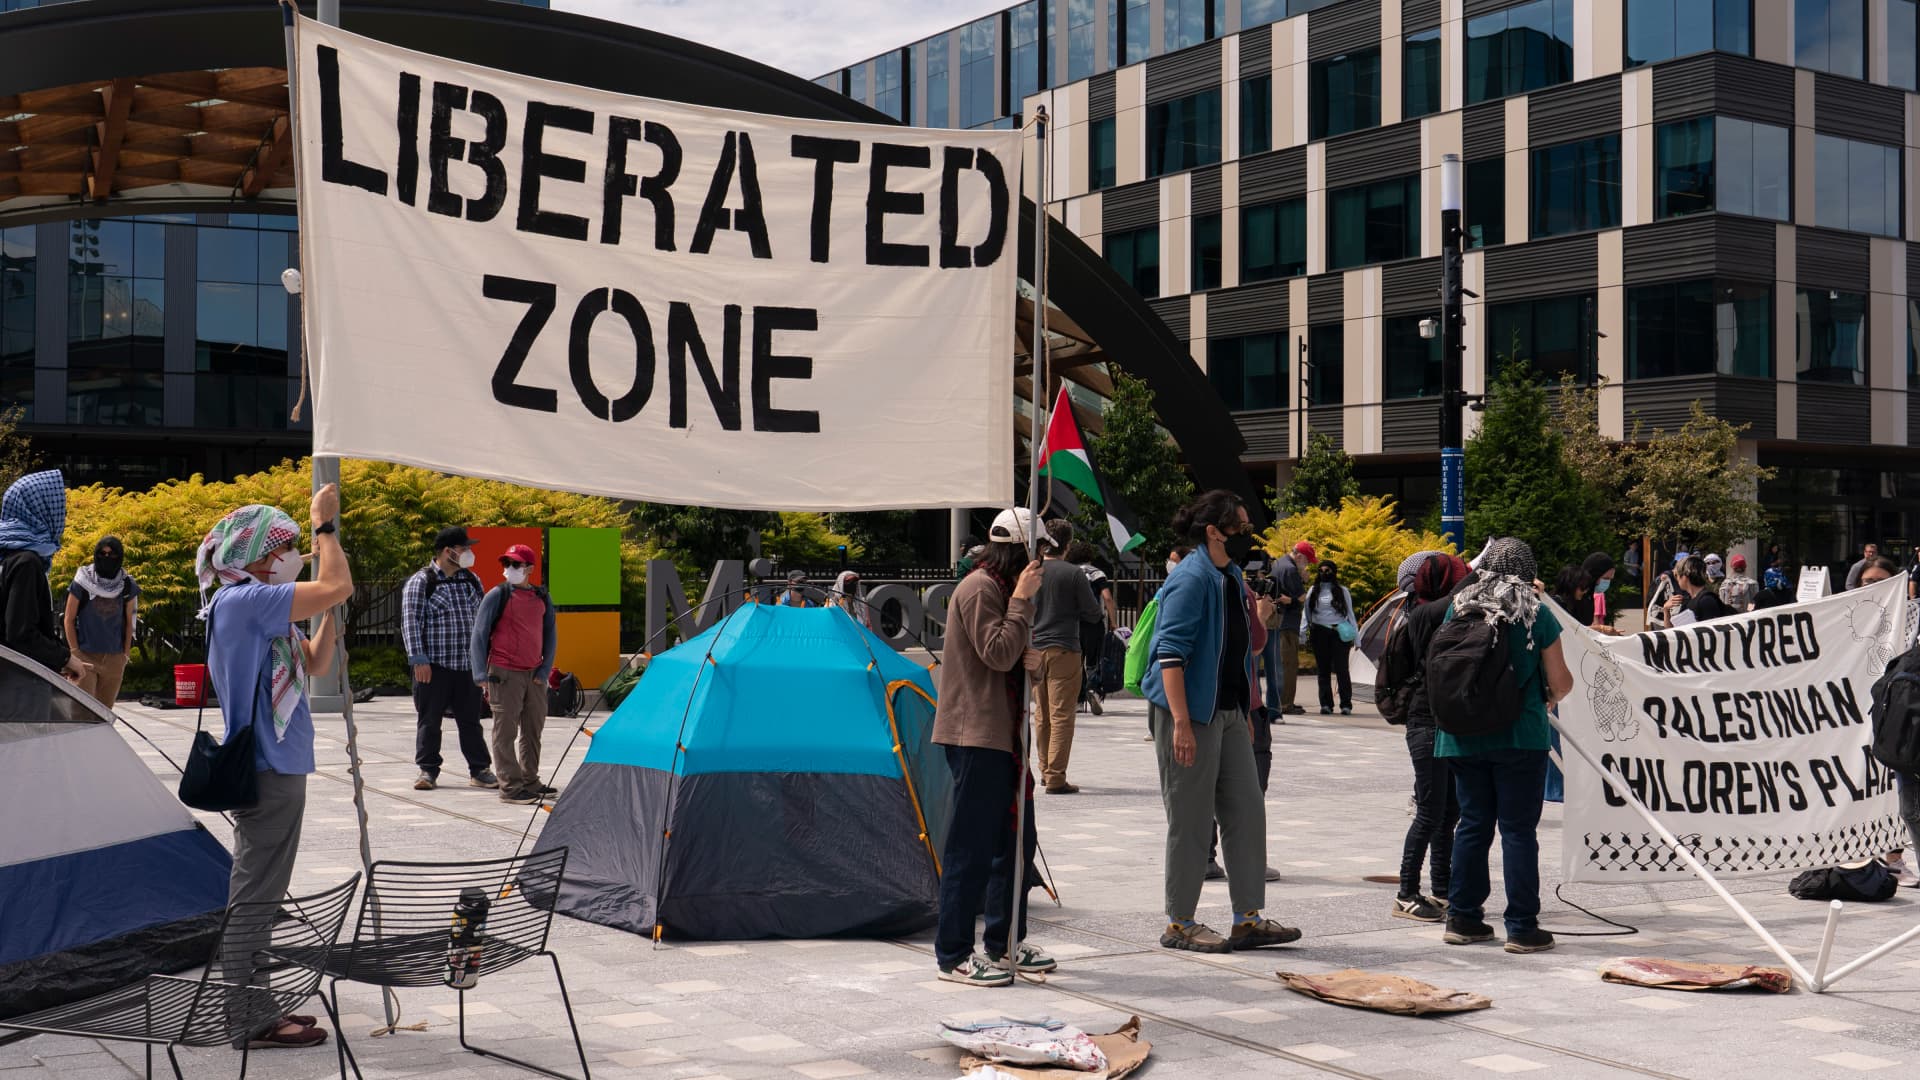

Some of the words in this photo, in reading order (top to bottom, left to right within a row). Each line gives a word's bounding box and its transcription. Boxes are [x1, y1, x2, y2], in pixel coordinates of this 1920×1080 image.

[317, 44, 1010, 269] LIBERATED
[482, 274, 821, 434] ZONE
[1638, 611, 1820, 674] MARTYRED
[1643, 677, 1864, 743] PALESTINIAN
[1601, 753, 1809, 815] CHILDREN'S
